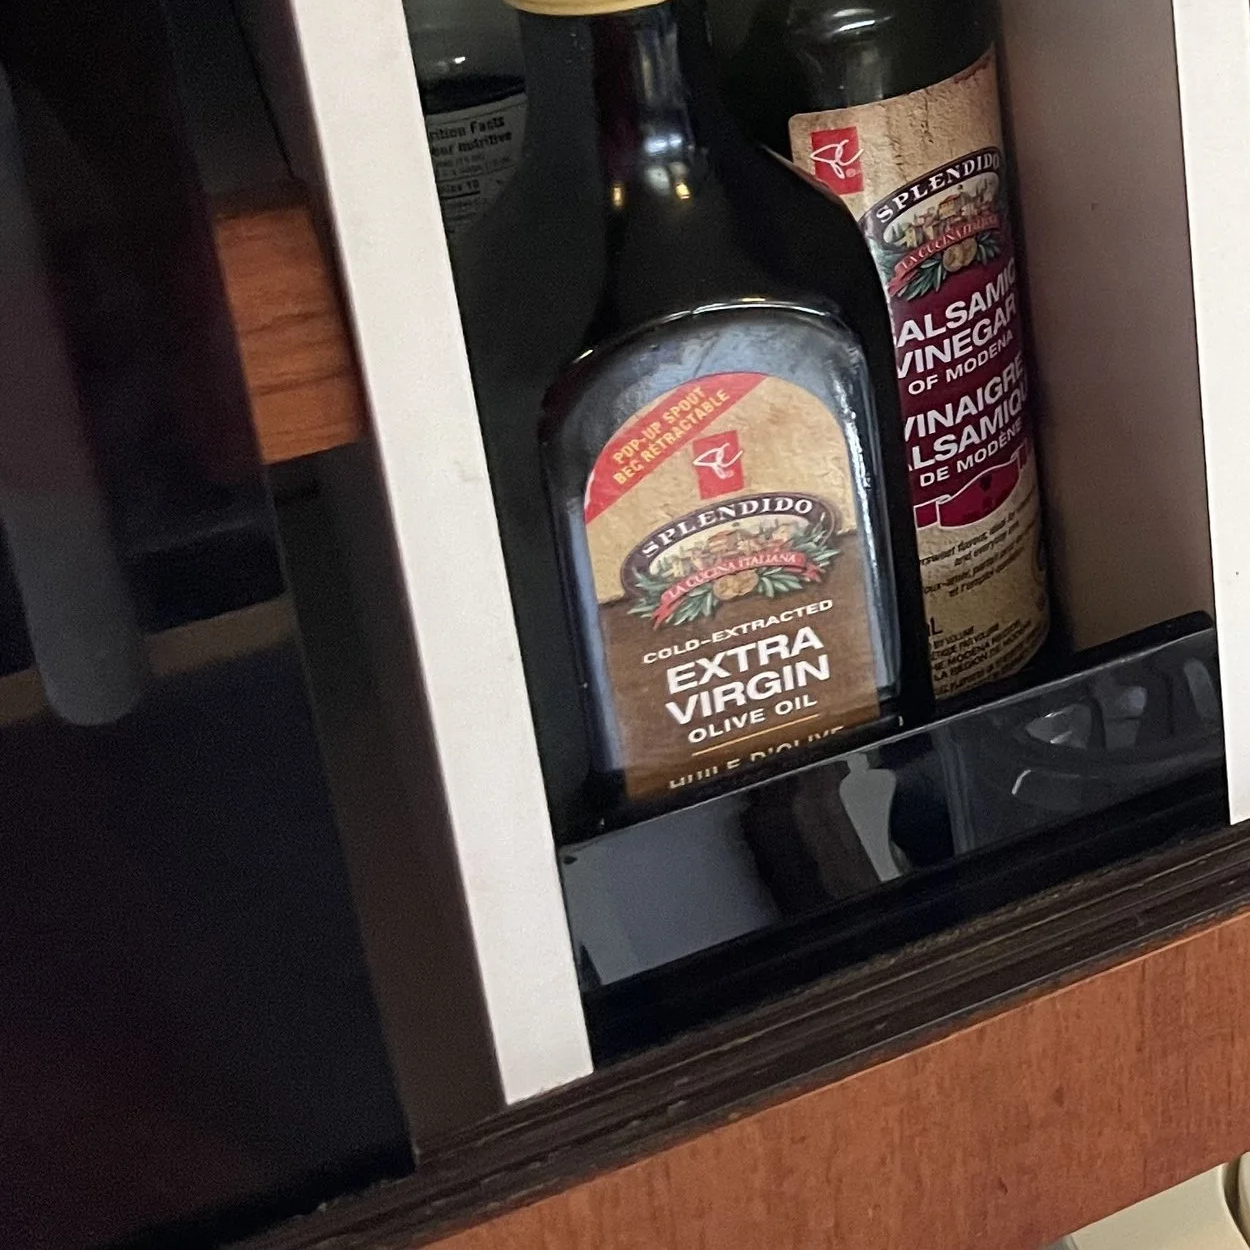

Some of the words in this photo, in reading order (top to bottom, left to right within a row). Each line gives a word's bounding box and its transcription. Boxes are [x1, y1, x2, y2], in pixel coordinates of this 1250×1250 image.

[876, 153, 1000, 223] SPLENDIDO
[897, 257, 1017, 348] ALSAMIC
[897, 292, 1017, 379] VINEGAR
[908, 373, 940, 396] OF
[945, 329, 1014, 383] MODENA
[612, 459, 645, 485] BEC
[640, 389, 731, 463] RÉTRACTABLE
[613, 421, 662, 465] POP-UP
[661, 386, 706, 424] SPOUT
[919, 470, 950, 488] DE
[956, 416, 1023, 474] MODÈNE
[642, 497, 814, 558] SPLENDIDO
[668, 584, 686, 599] LA
[687, 562, 735, 587] CUCINA
[738, 553, 798, 569] ITALIANA
[642, 600, 834, 664] COLD-EXTRACTED
[666, 626, 824, 694] EXTRA
[665, 654, 830, 725] VIRGIN
[687, 708, 766, 744] OLIVE
[774, 694, 818, 716] OIL
